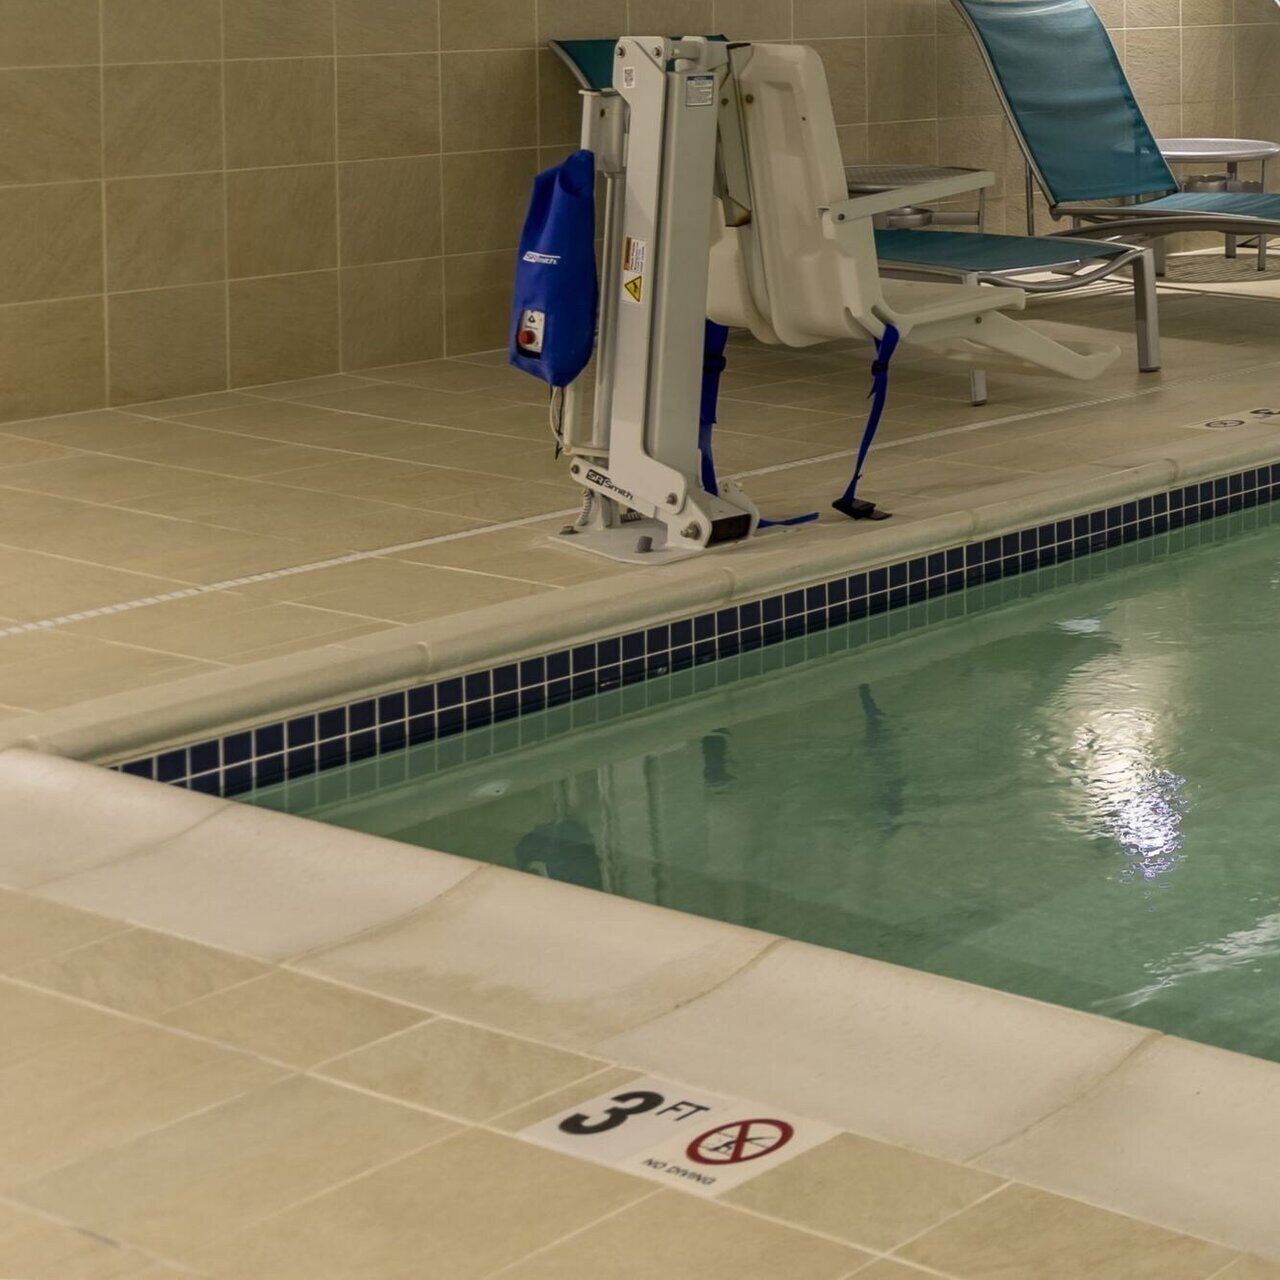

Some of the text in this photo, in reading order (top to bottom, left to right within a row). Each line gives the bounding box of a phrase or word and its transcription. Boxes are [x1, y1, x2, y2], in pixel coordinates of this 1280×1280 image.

[557, 1090, 712, 1136] 3 FT
[643, 1157, 718, 1187] NO DIVING
